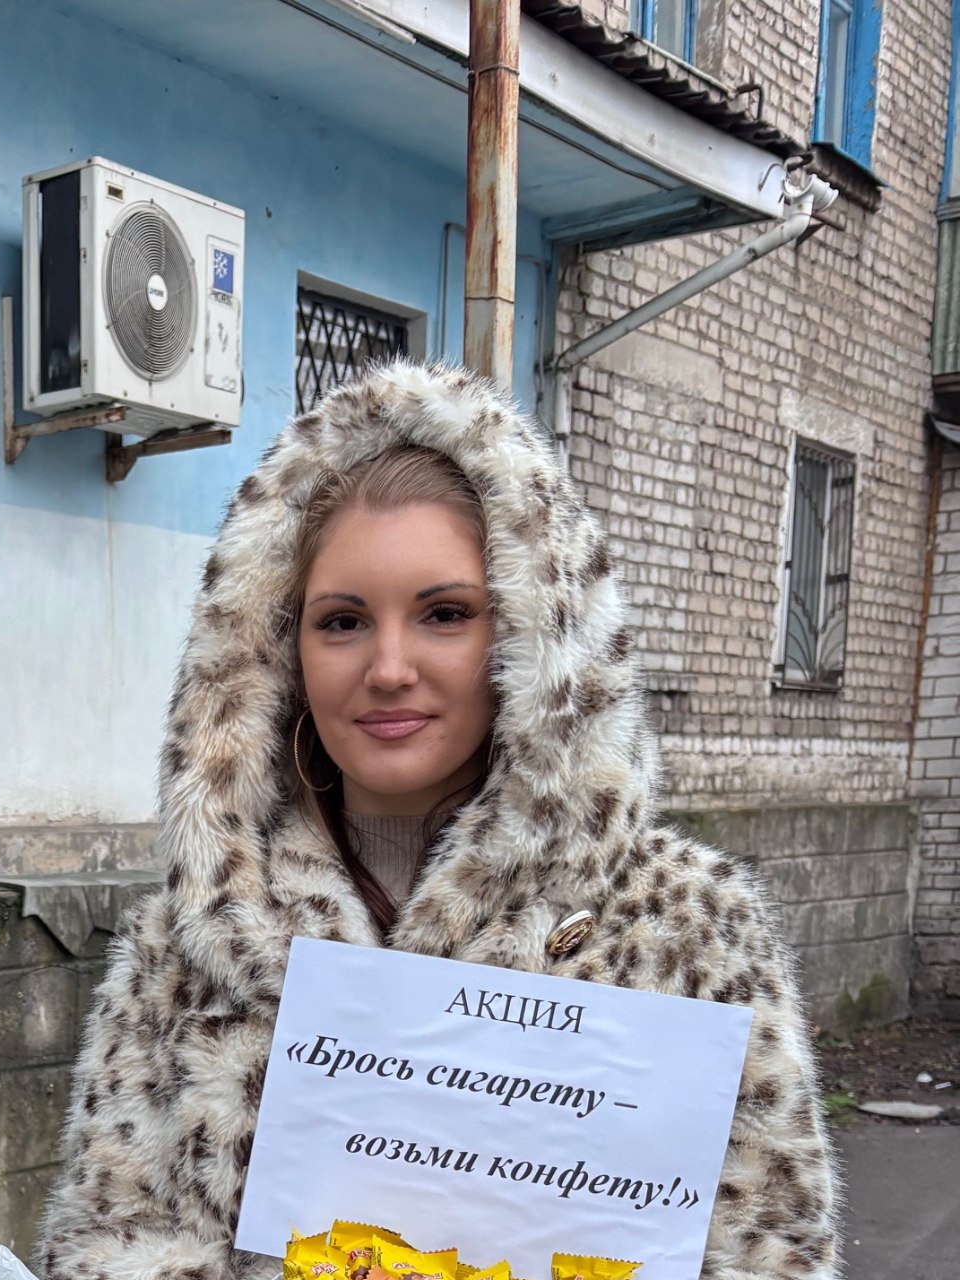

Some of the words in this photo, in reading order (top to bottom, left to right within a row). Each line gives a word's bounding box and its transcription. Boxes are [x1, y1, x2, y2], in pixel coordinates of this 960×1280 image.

[444, 986, 586, 1034] АКЦИЯ
[286, 1035, 414, 1081] «Брось
[426, 1065, 606, 1119] сигарету
[345, 1133, 479, 1173] возьми
[486, 1156, 701, 1211] конфету!»
